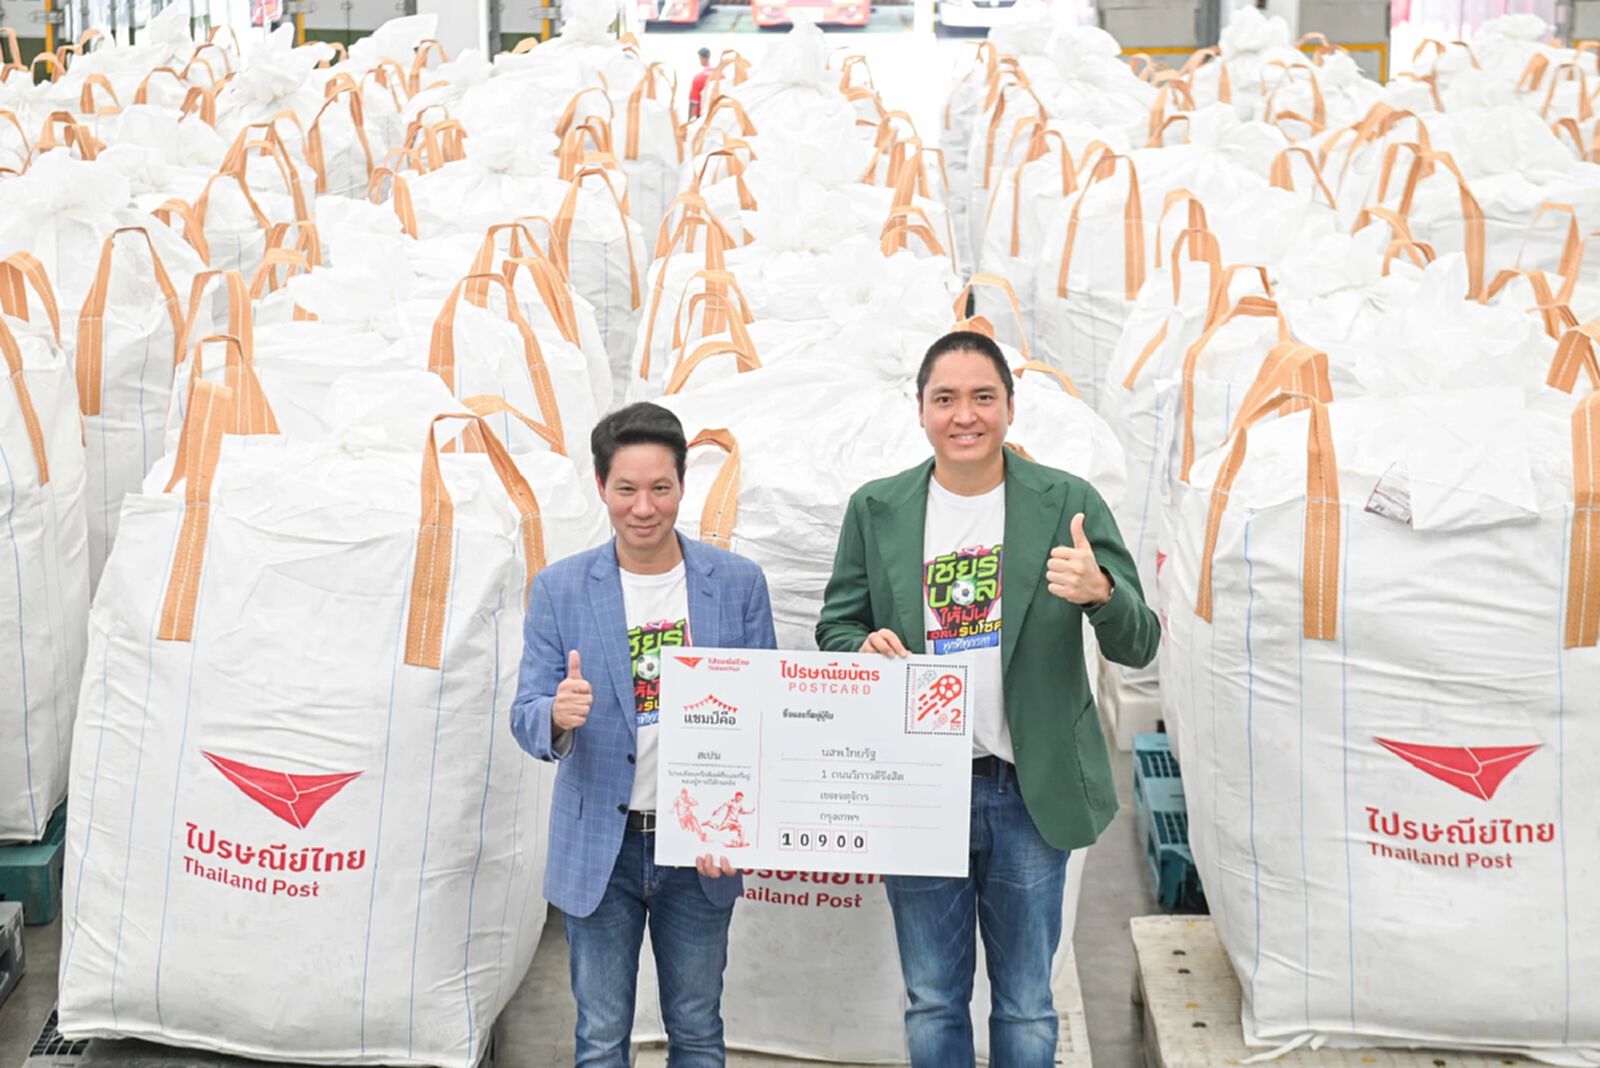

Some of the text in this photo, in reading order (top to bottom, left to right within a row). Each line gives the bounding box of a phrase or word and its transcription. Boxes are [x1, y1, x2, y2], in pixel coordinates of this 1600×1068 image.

[780, 660, 880, 682] ไปรษณียบัตร
[788, 682, 871, 695] POSTCARD
[950, 708, 962, 723] 2
[821, 769, 828, 779] 1
[1365, 806, 1555, 845] ไปรษณีย์ไทย
[186, 822, 366, 873] ไปรษณีย์ไทย
[782, 833, 864, 848] 10900
[1367, 841, 1513, 869] Thailand Post
[183, 856, 320, 898] Thailand Post
[741, 886, 862, 908] ailand Post
